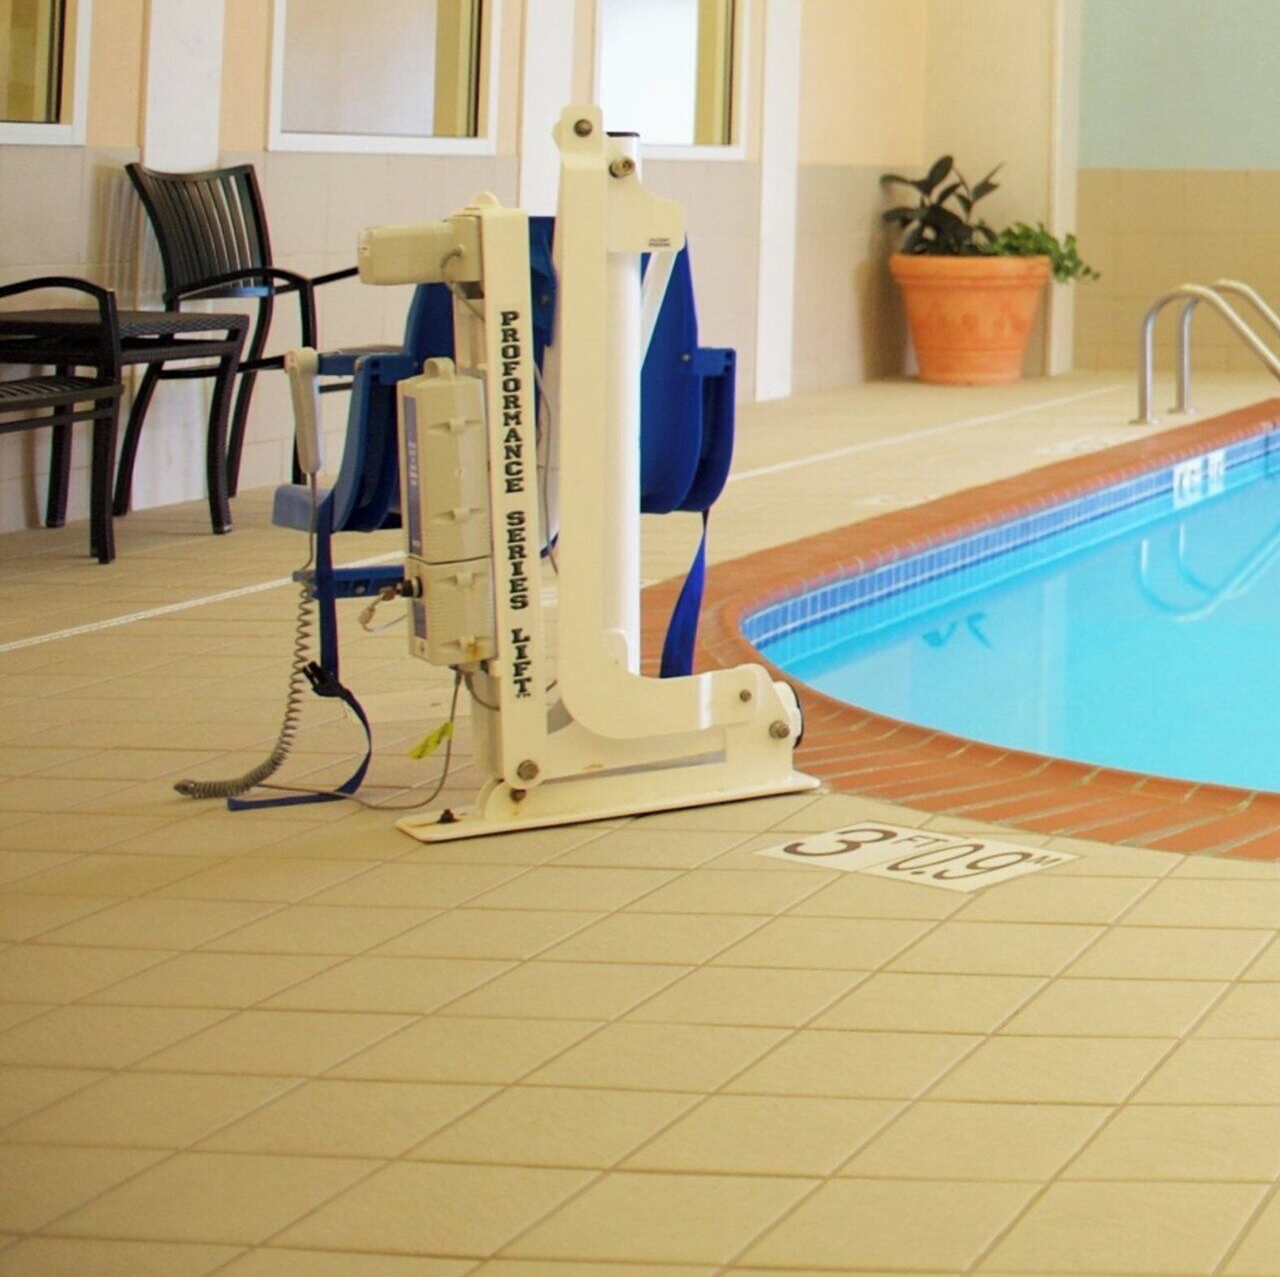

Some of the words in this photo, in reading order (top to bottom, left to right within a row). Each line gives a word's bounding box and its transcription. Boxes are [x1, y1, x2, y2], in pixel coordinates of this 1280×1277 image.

[500, 310, 524, 494] PROFORMANCE
[506, 510, 529, 610] SERIES
[783, 828, 898, 857] 3
[892, 834, 950, 849] FT
